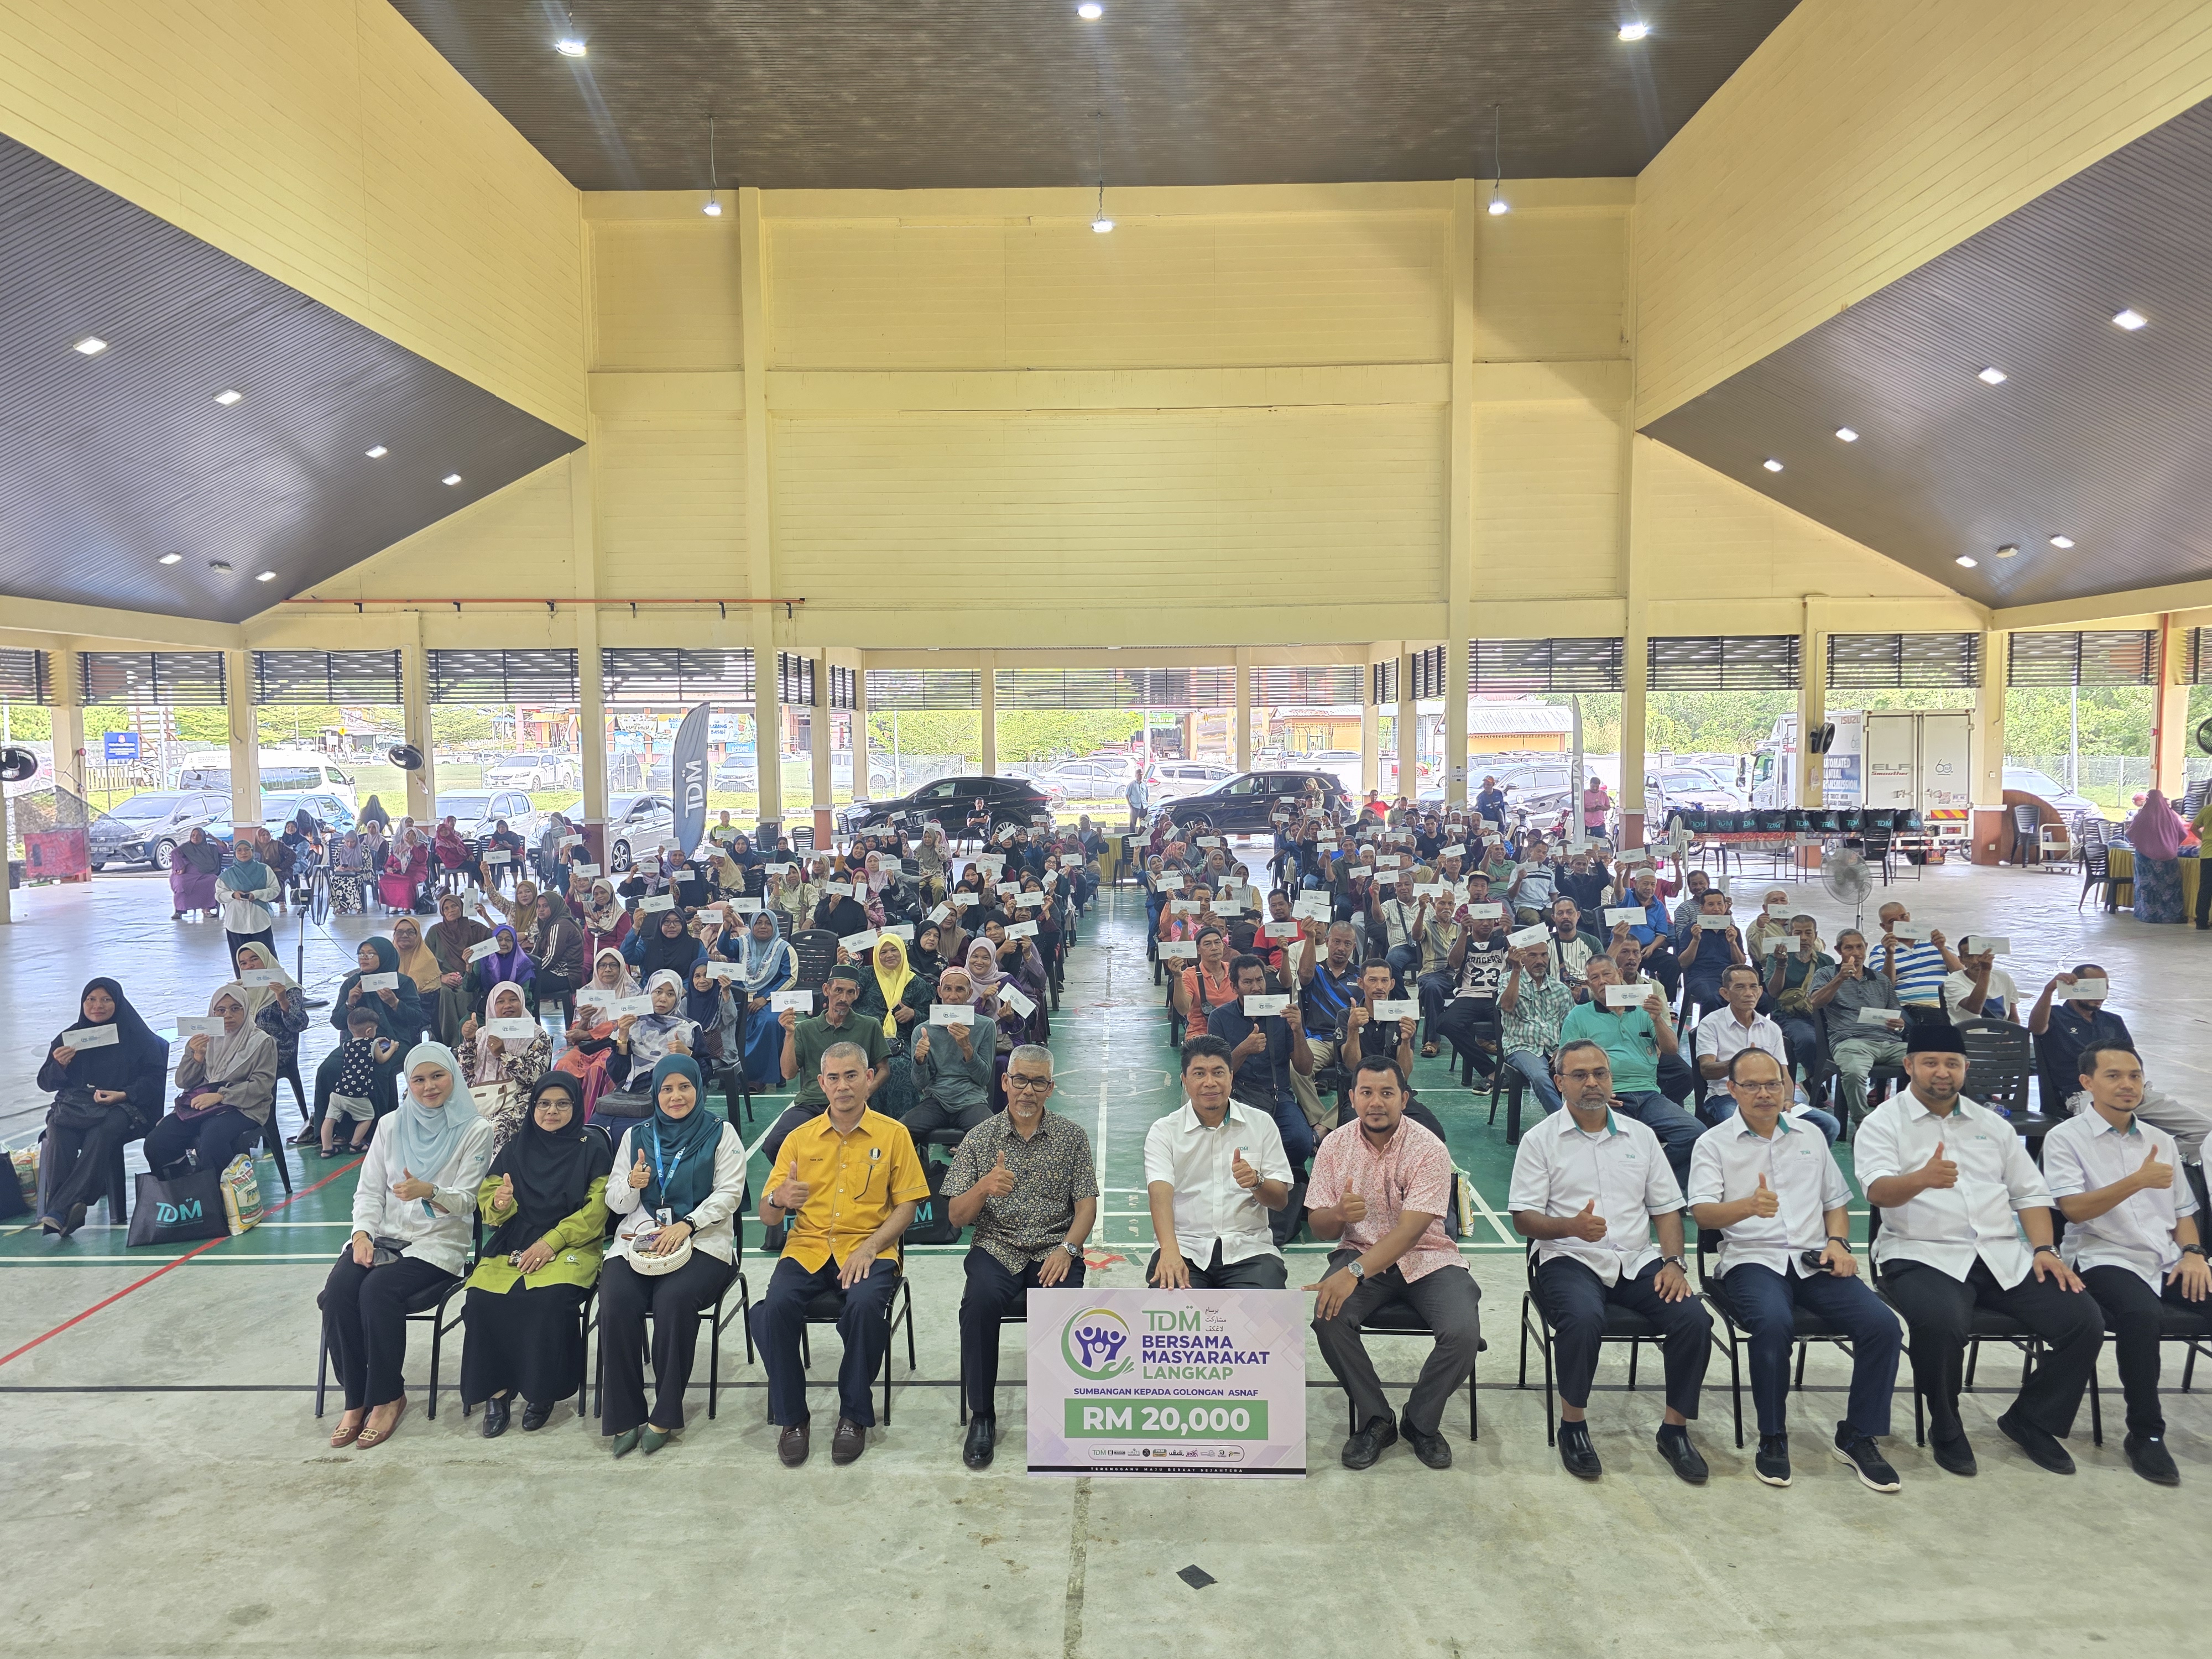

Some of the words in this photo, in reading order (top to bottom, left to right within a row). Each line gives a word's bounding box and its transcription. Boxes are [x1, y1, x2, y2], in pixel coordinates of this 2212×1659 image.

[1823, 758, 1851, 768] UTOMATED
[682, 760, 704, 818] TDM
[1823, 780, 1858, 790] RANSMISSION
[1794, 818, 1809, 827] TDM
[1466, 955, 1502, 964] RANGERS
[1470, 967, 1500, 987] 23
[156, 1197, 202, 1223] TDM
[1141, 1305, 1201, 1332] TDM
[1142, 1335, 1233, 1349] BERSAMA
[1142, 1350, 1270, 1364] MASYARAKAT
[1142, 1366, 1233, 1380] LANGKAP
[1083, 1406, 1132, 1430] RM
[1141, 1406, 1250, 1436] 20,000
